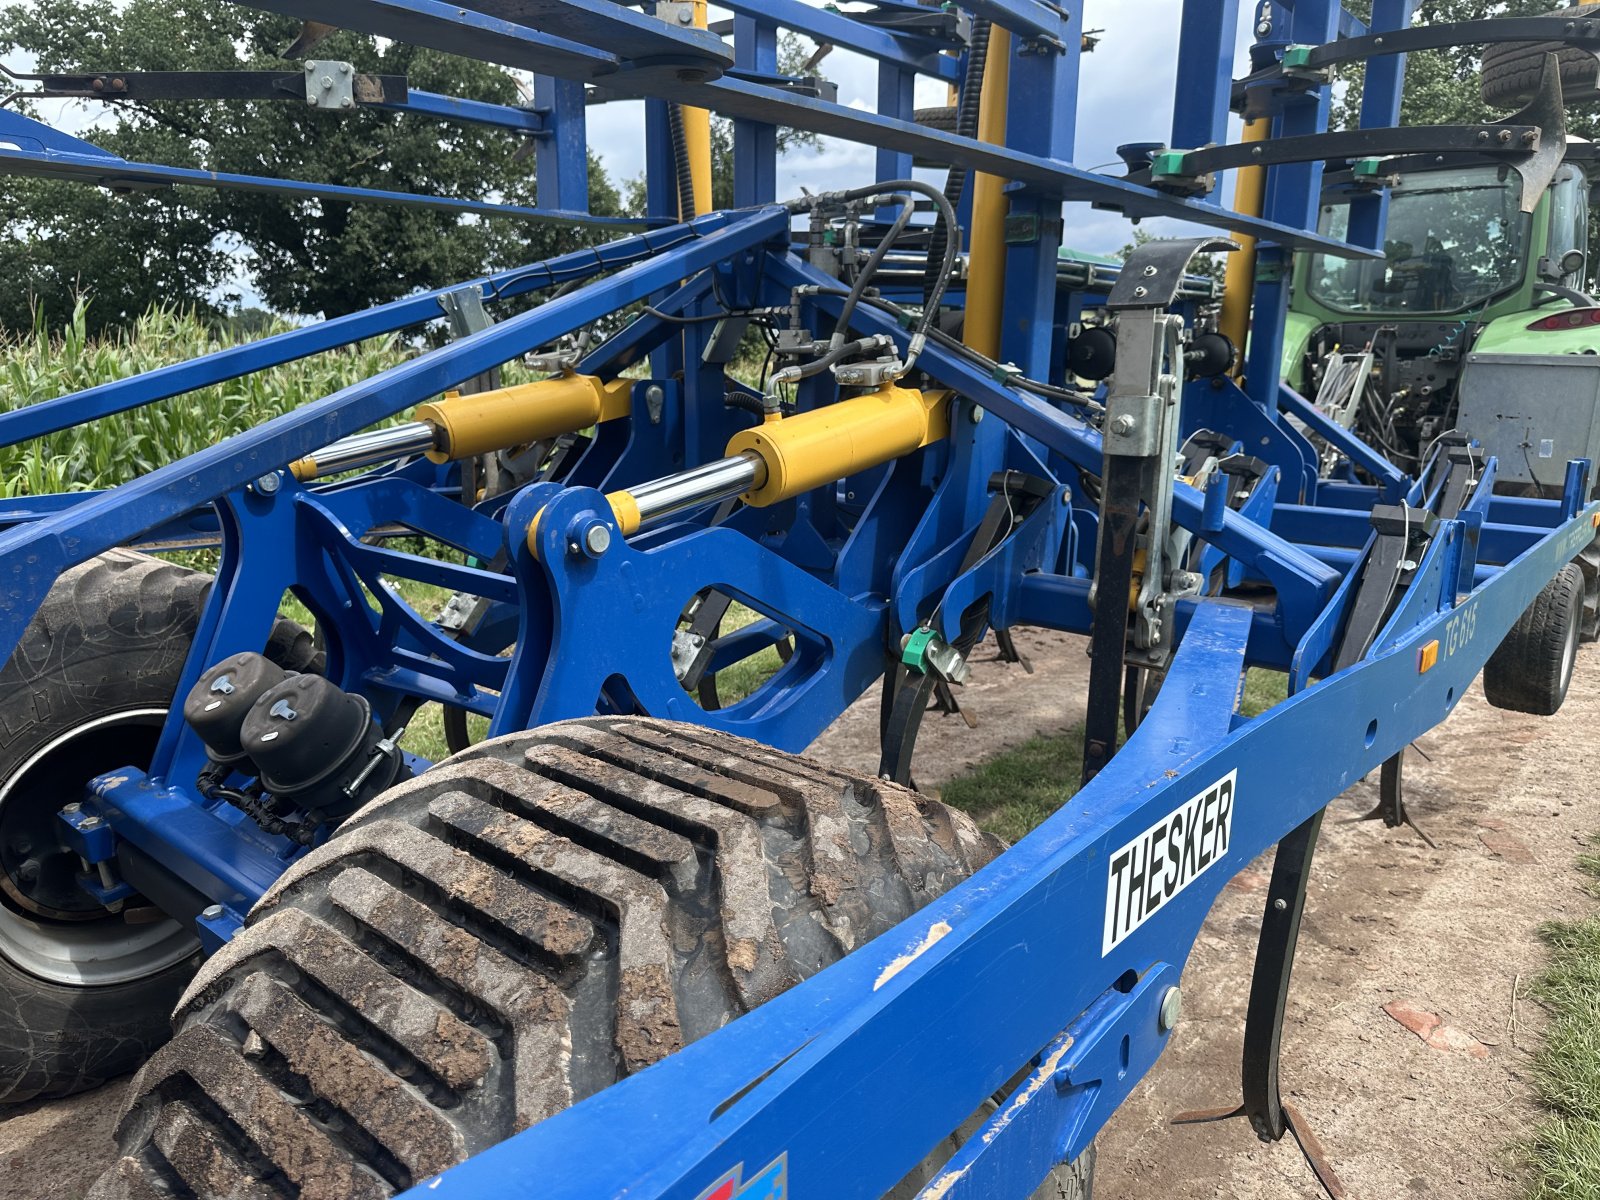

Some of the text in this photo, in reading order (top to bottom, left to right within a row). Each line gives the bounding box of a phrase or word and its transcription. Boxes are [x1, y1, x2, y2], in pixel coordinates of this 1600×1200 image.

[1443, 601, 1478, 661] TG 615
[1111, 779, 1232, 944] THESKER
